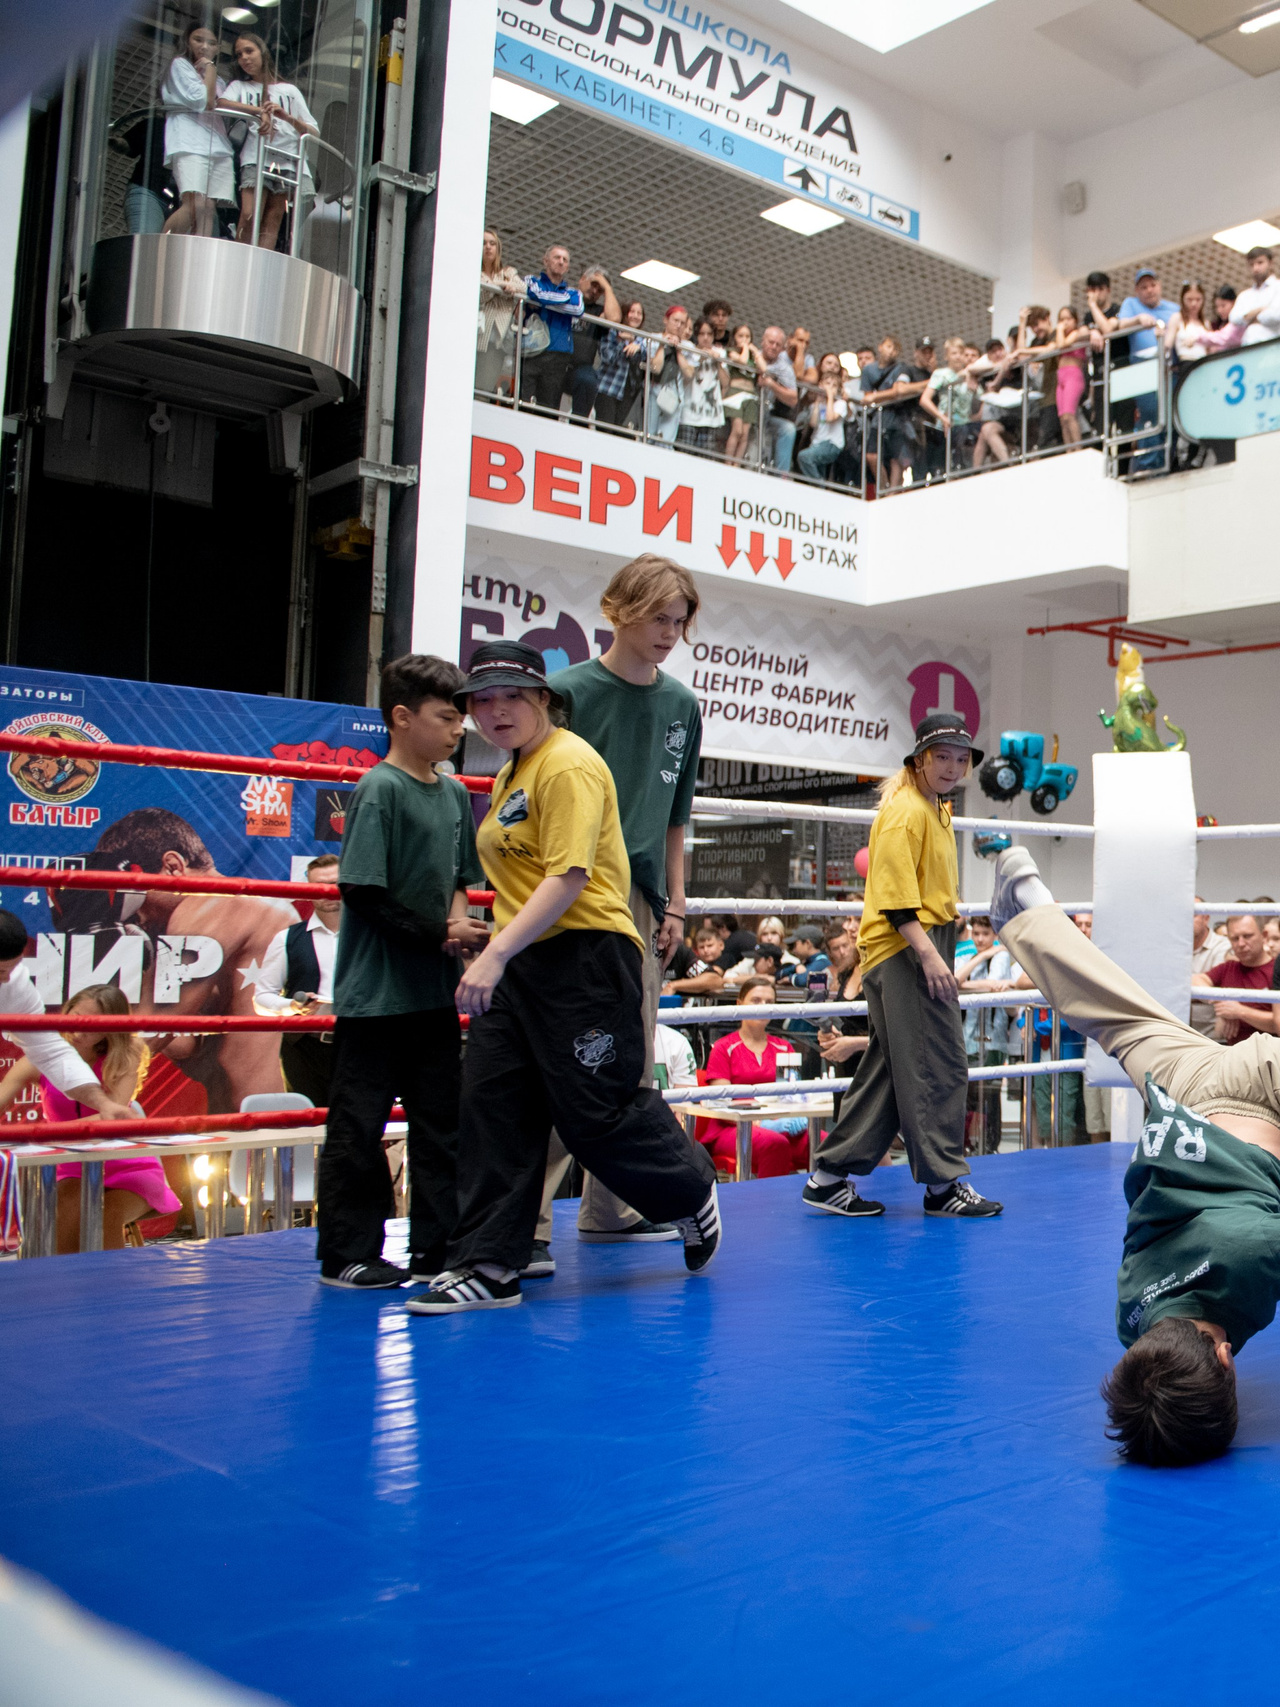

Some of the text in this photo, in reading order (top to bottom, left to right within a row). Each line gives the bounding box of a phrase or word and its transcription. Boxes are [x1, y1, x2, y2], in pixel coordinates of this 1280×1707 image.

[514, 0, 858, 154] ОРМУЛА
[555, 64, 682, 136] КАБИНЕТ:
[699, 128, 735, 157] 4.6
[745, 114, 861, 177] ВОЖДЕНИЯ
[1224, 364, 1246, 406] 3
[469, 435, 859, 545] ВЕРИ ЦОКОЛЬНЫЙ
[802, 543, 858, 572] ЭТАЖ
[692, 642, 809, 678] ОБОЙНЫЙ
[692, 670, 856, 711] ЦЕНТР ФАБРИК
[4, 713, 83, 735] ОЙЦОВСКИЙ
[698, 698, 889, 741] ПРОИЗВОДИТЕЛЕЙ
[703, 759, 753, 788] BODY
[722, 785, 763, 797] МАГАЗИНОВ
[10, 803, 100, 828] БАТЫР
[723, 828, 783, 846] МАГАЗИНОВ
[698, 847, 766, 865] СПОРТИВНОГО
[697, 866, 742, 882] ПИТАНИЯ
